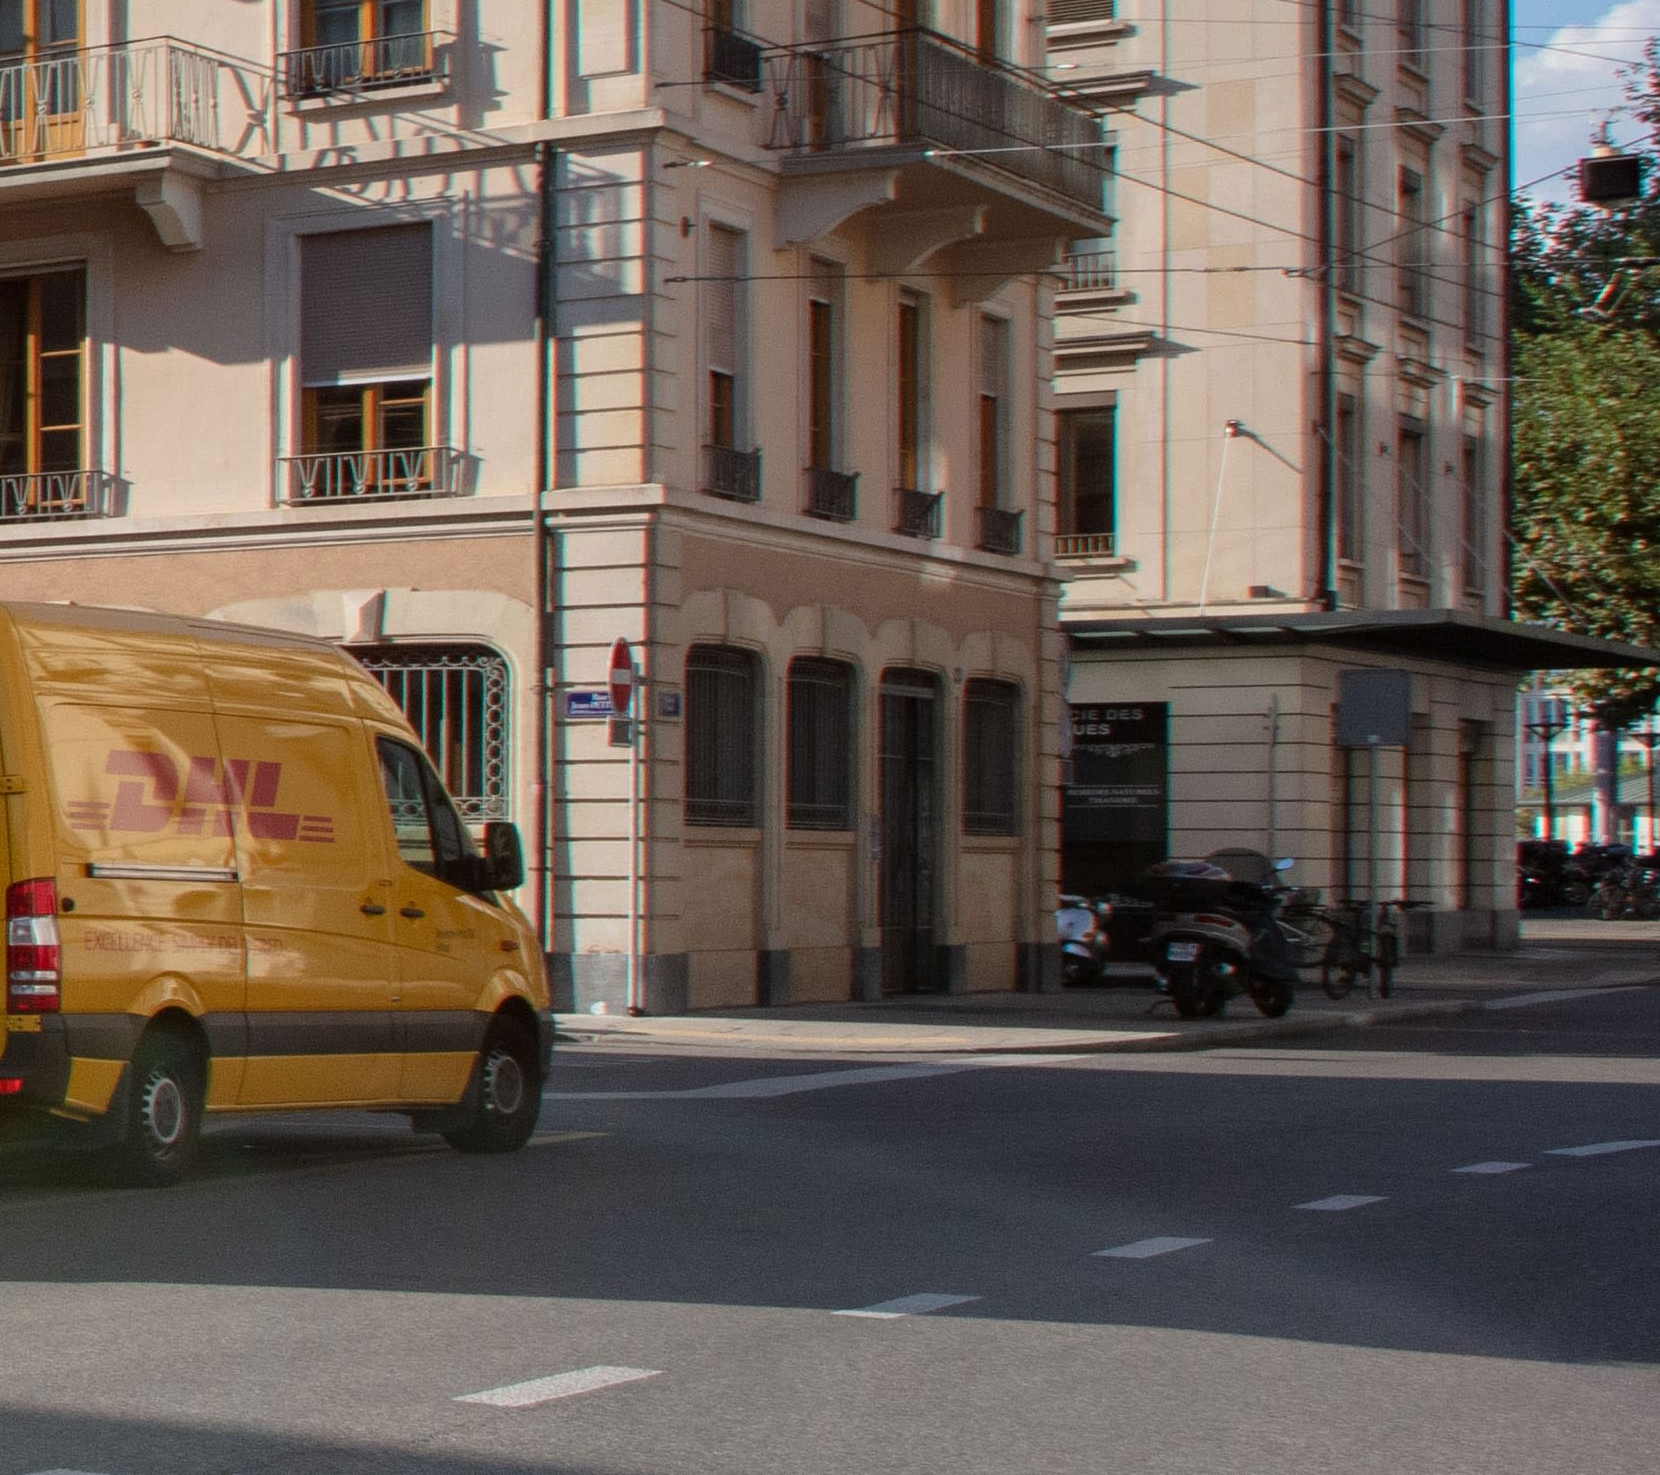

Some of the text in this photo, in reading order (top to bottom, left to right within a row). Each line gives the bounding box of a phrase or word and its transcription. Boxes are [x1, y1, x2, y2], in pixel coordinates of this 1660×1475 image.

[1106, 709, 1143, 720] DES
[1073, 723, 1111, 736] UES
[105, 749, 300, 840] DHL
